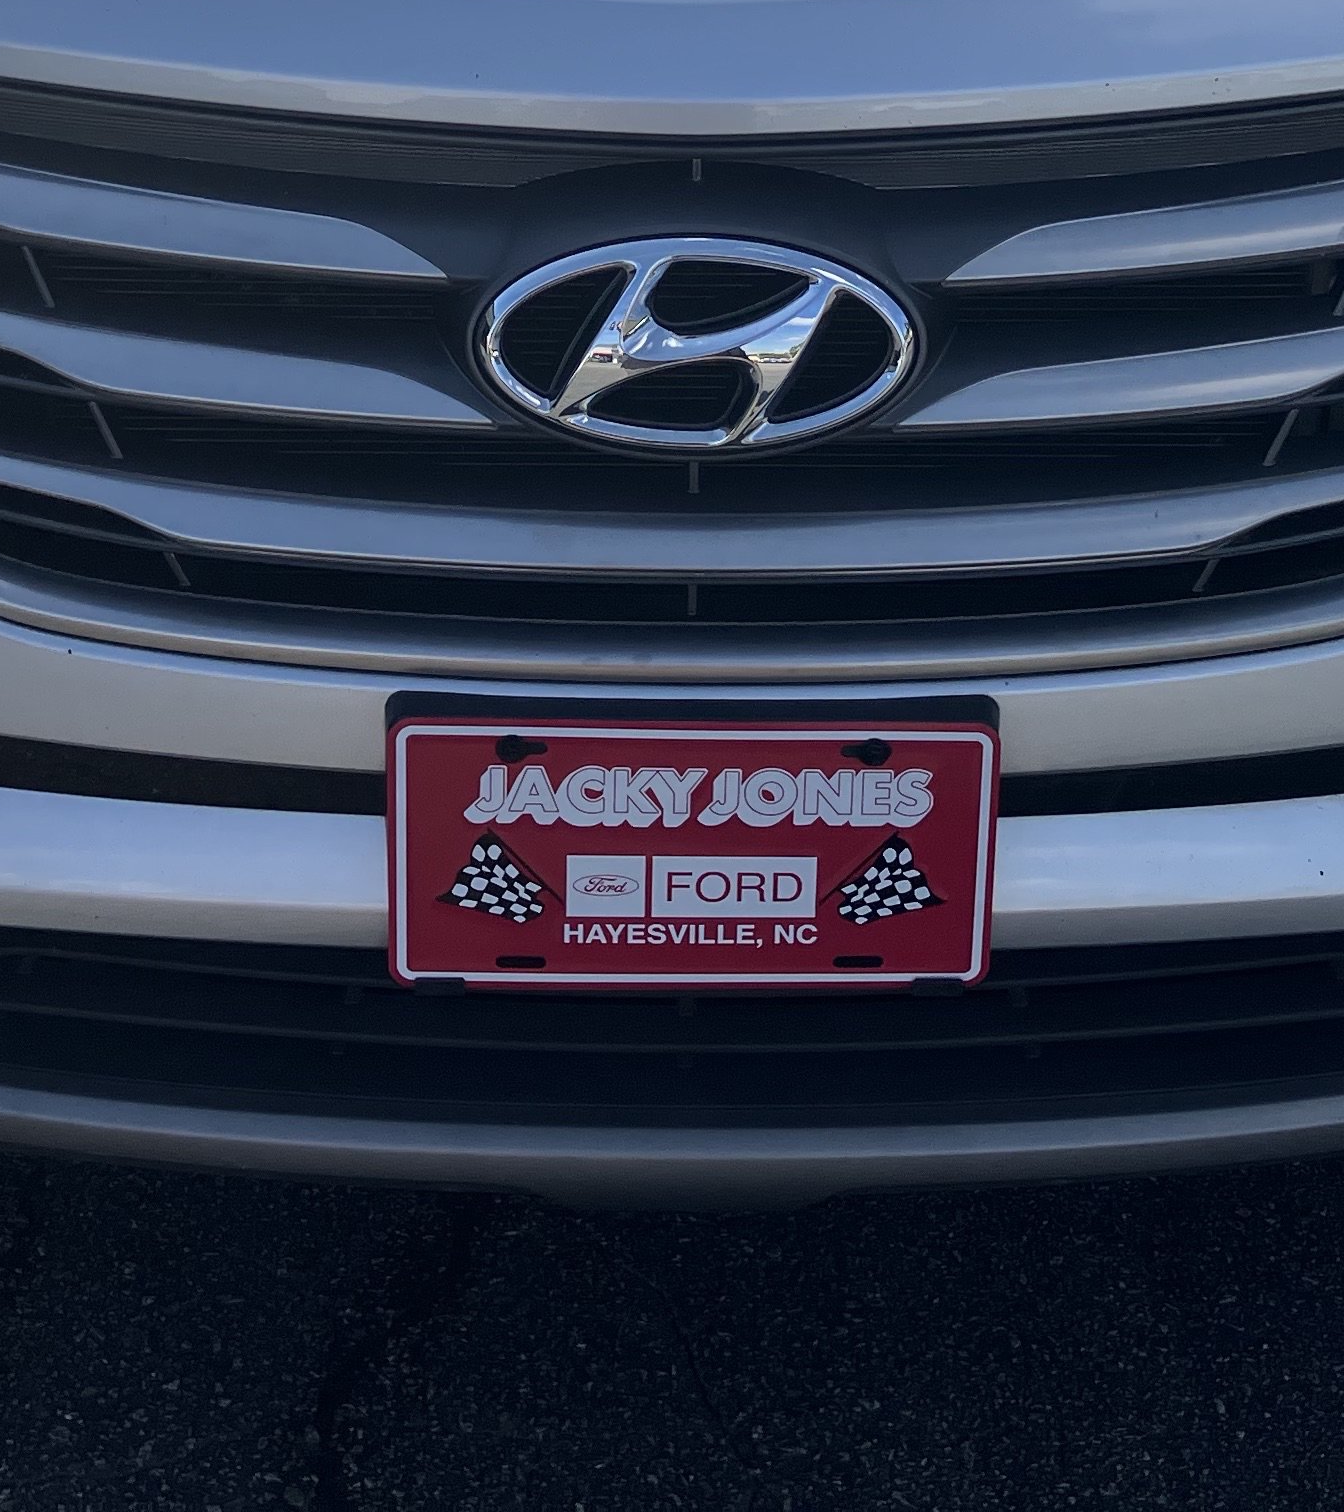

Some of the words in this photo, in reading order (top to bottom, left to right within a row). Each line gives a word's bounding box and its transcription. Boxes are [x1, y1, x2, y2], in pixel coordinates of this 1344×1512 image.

[463, 764, 709, 829] JACKY
[697, 767, 934, 829] JONES
[584, 876, 628, 894] Ford
[665, 871, 804, 903] FORD
[563, 923, 763, 949] HAYESVILLE,
[774, 924, 818, 944] NC
